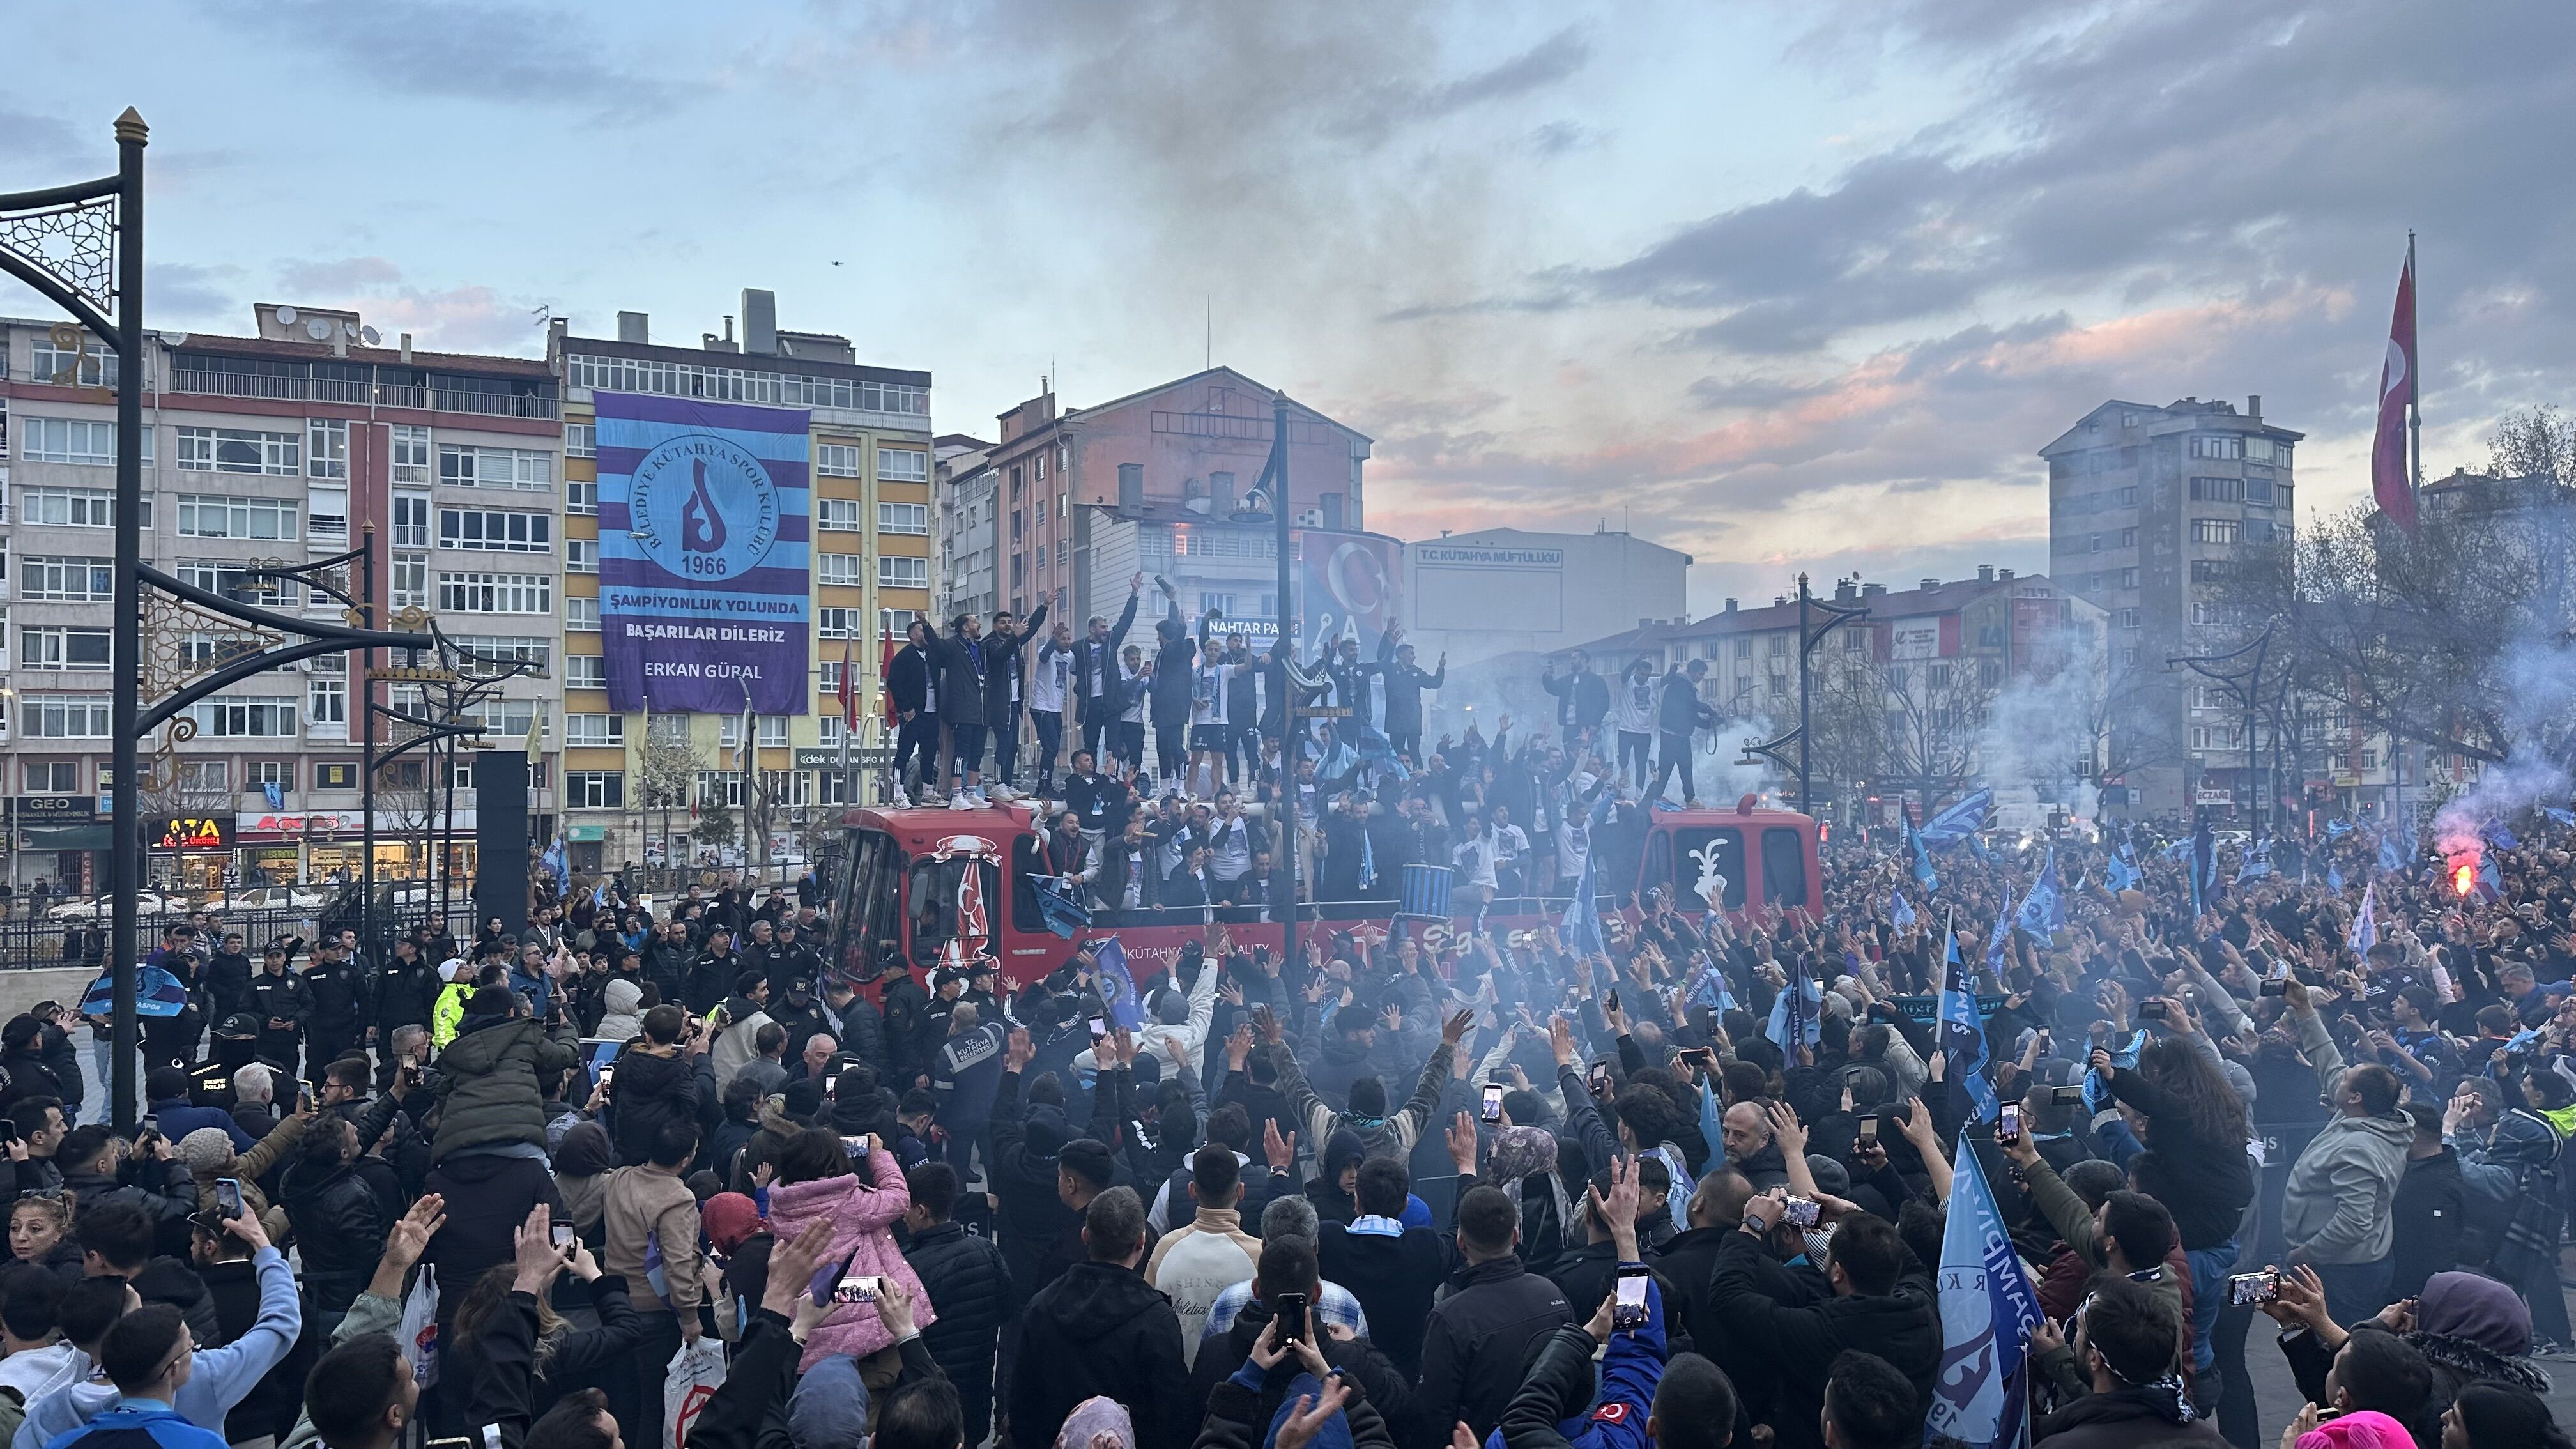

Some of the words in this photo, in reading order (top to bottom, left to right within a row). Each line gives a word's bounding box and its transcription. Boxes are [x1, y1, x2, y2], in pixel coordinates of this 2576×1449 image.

[634, 470, 662, 549] BELEDİYE
[652, 443, 726, 470] KÜTAHYA
[730, 454, 763, 489] SPOR
[747, 493, 771, 556] KULÜBÜ
[682, 555, 726, 575] 1966
[1441, 549, 1492, 562] KÜTAHYA
[610, 593, 722, 611] ŞAMPİYONLUK
[725, 599, 799, 614] YOLUNDA
[626, 623, 717, 641] BAŞARILAR
[721, 624, 785, 643] DİLERİZ
[645, 662, 700, 677] ERKAN
[705, 661, 762, 679] GÜRAL
[805, 754, 826, 764] dek
[30, 799, 69, 809] GEO
